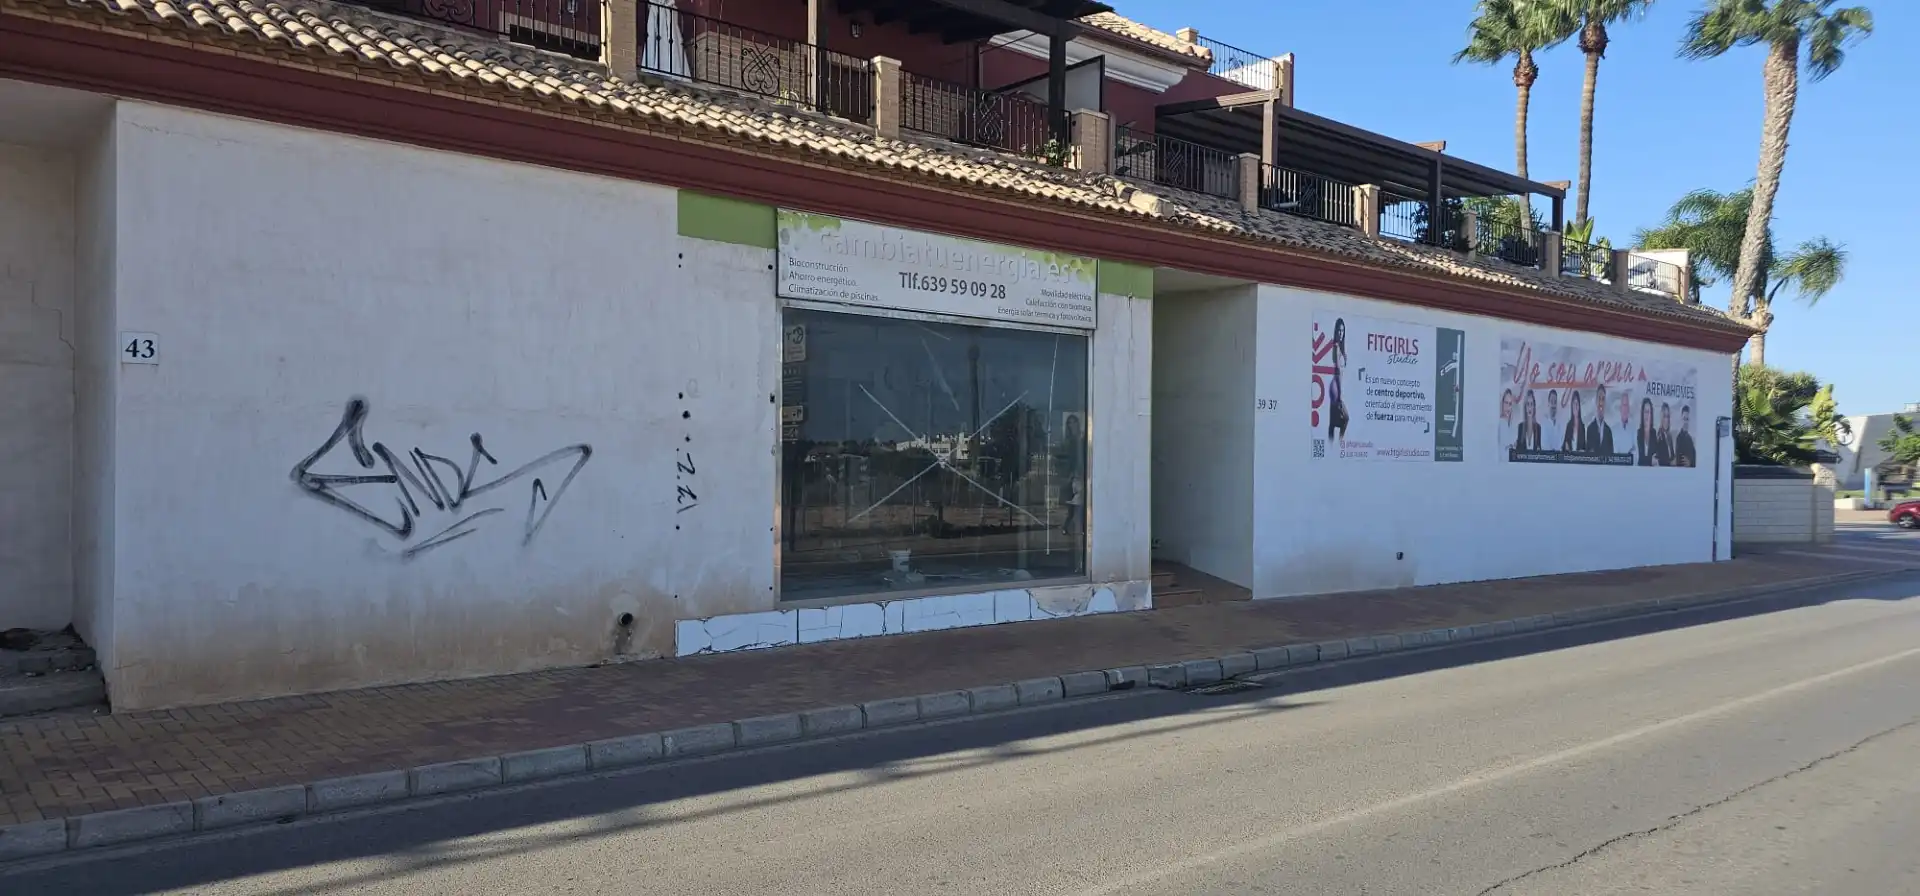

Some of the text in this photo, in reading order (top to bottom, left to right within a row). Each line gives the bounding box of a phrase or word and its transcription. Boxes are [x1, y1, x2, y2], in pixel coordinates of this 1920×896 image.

[789, 256, 849, 273] Bioconstrucción
[788, 271, 816, 282] Ahorro
[788, 283, 838, 297] Climatización
[839, 289, 849, 299] de
[898, 271, 1006, 300] Tlf.639 59 09 28
[1041, 288, 1068, 299] Movilidad
[1025, 298, 1057, 309] Calefacción
[1057, 301, 1069, 310] con
[1020, 308, 1034, 317] solar
[1055, 313, 1060, 321] y
[125, 338, 155, 359] 43
[1367, 332, 1419, 356] FITGIRLS
[1386, 353, 1418, 365] studio
[1504, 341, 1635, 408] Yo soy arena
[1372, 376, 1380, 384] un
[1380, 377, 1397, 386] nuevo
[1396, 378, 1421, 388] concepto
[1366, 386, 1426, 400] de centro deportivo,
[1645, 382, 1695, 399] ARENAHOMES
[1257, 398, 1278, 411] 39 37
[1364, 400, 1432, 412] orientado al entrenamiento
[1366, 411, 1374, 421] de
[1374, 411, 1394, 421] fuerza
[1394, 414, 1406, 422] para
